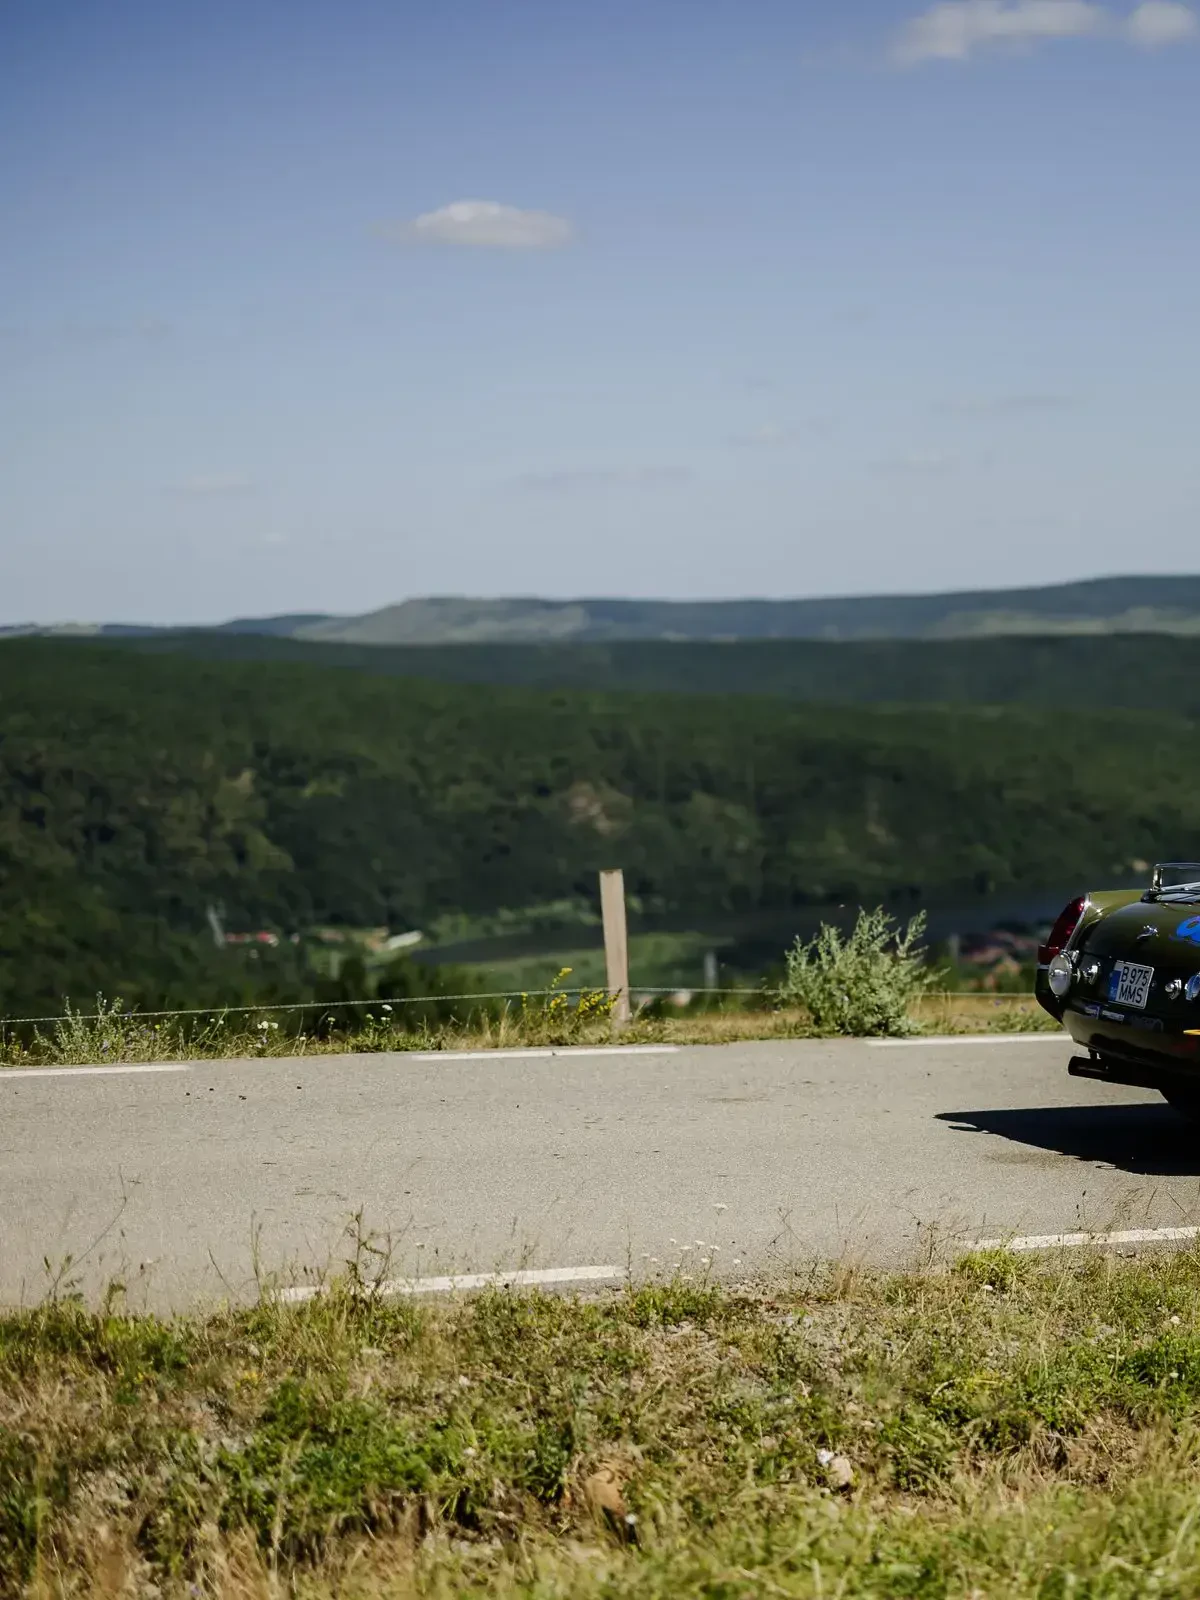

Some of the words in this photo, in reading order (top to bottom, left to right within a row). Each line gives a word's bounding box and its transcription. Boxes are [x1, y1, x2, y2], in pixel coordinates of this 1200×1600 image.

[1121, 966, 1129, 982] B
[1129, 968, 1149, 987] 975
[1118, 983, 1143, 1004] MMS
